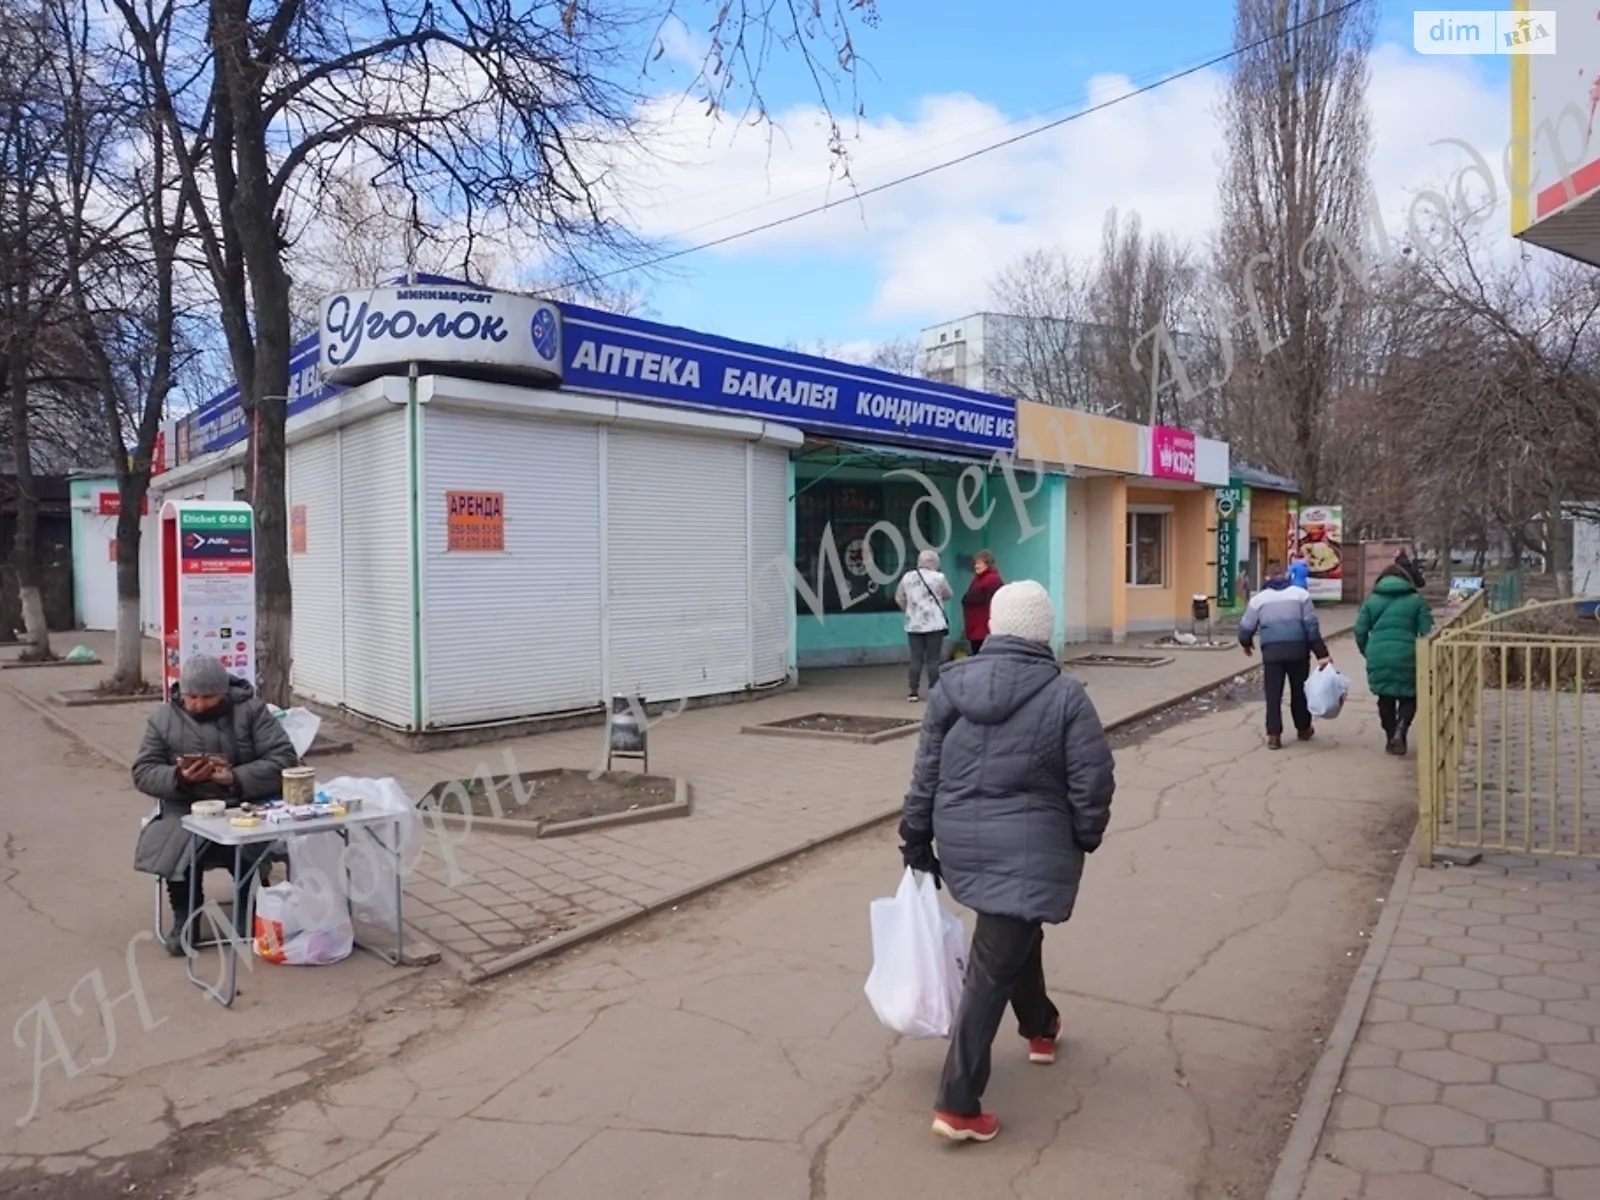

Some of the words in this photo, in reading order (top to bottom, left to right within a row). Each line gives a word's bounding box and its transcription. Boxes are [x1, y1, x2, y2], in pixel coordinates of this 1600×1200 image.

[397, 289, 492, 303] минимаркет
[326, 294, 508, 365] Уголок
[571, 340, 701, 388] АПТЕКА
[722, 367, 838, 411] БАКАЛЕЯ
[856, 391, 994, 437] КОНДИТЕРСКИЕ
[450, 495, 501, 520] АРЕНДА
